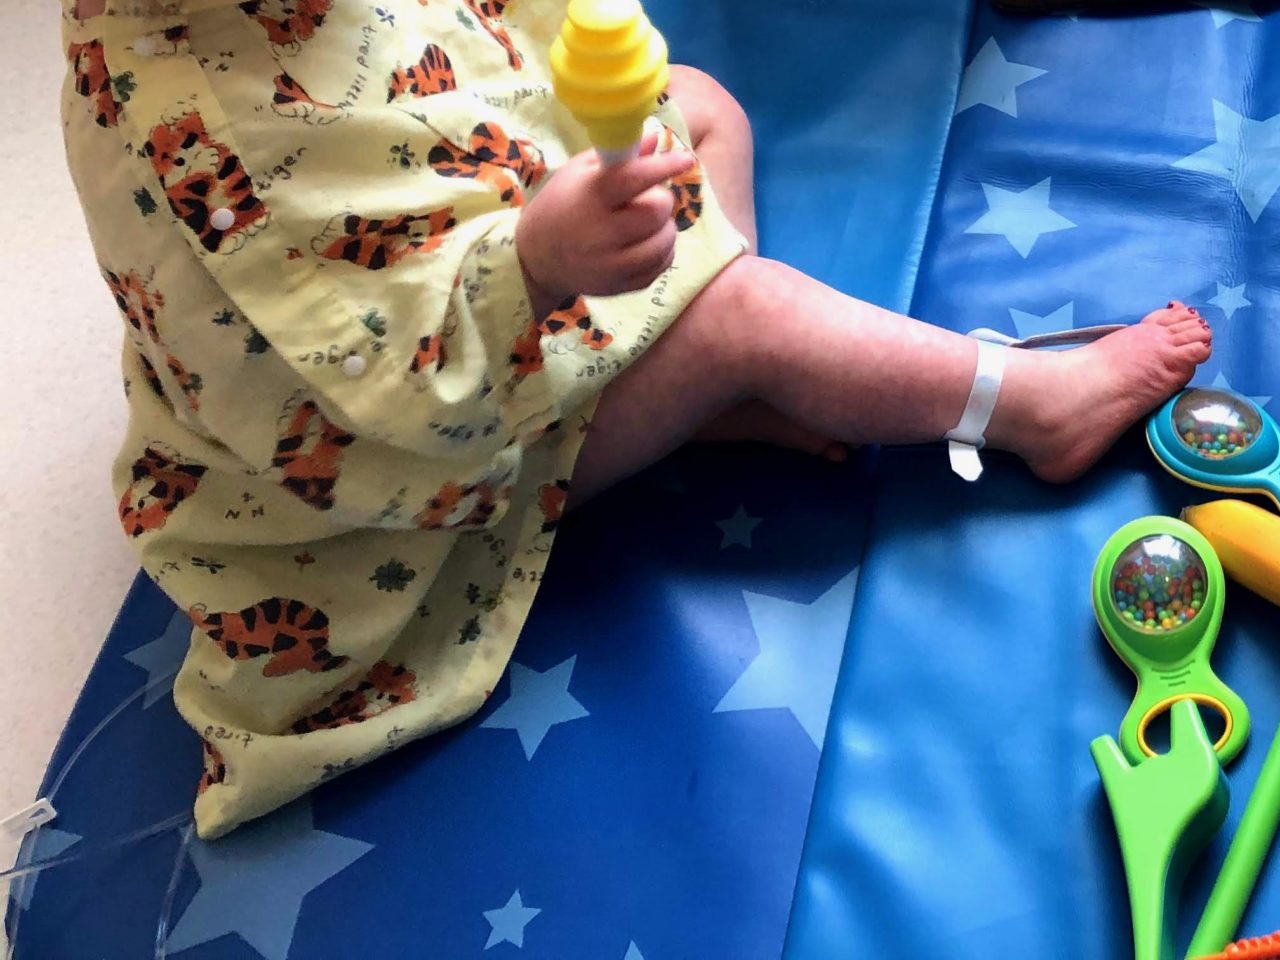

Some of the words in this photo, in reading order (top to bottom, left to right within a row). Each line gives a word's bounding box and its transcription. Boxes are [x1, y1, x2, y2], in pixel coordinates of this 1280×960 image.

[357, 24, 377, 69] tired
[256, 146, 307, 192] tiger
[298, 344, 358, 367] iger
[628, 314, 660, 357] little
[575, 356, 622, 378] tiger
